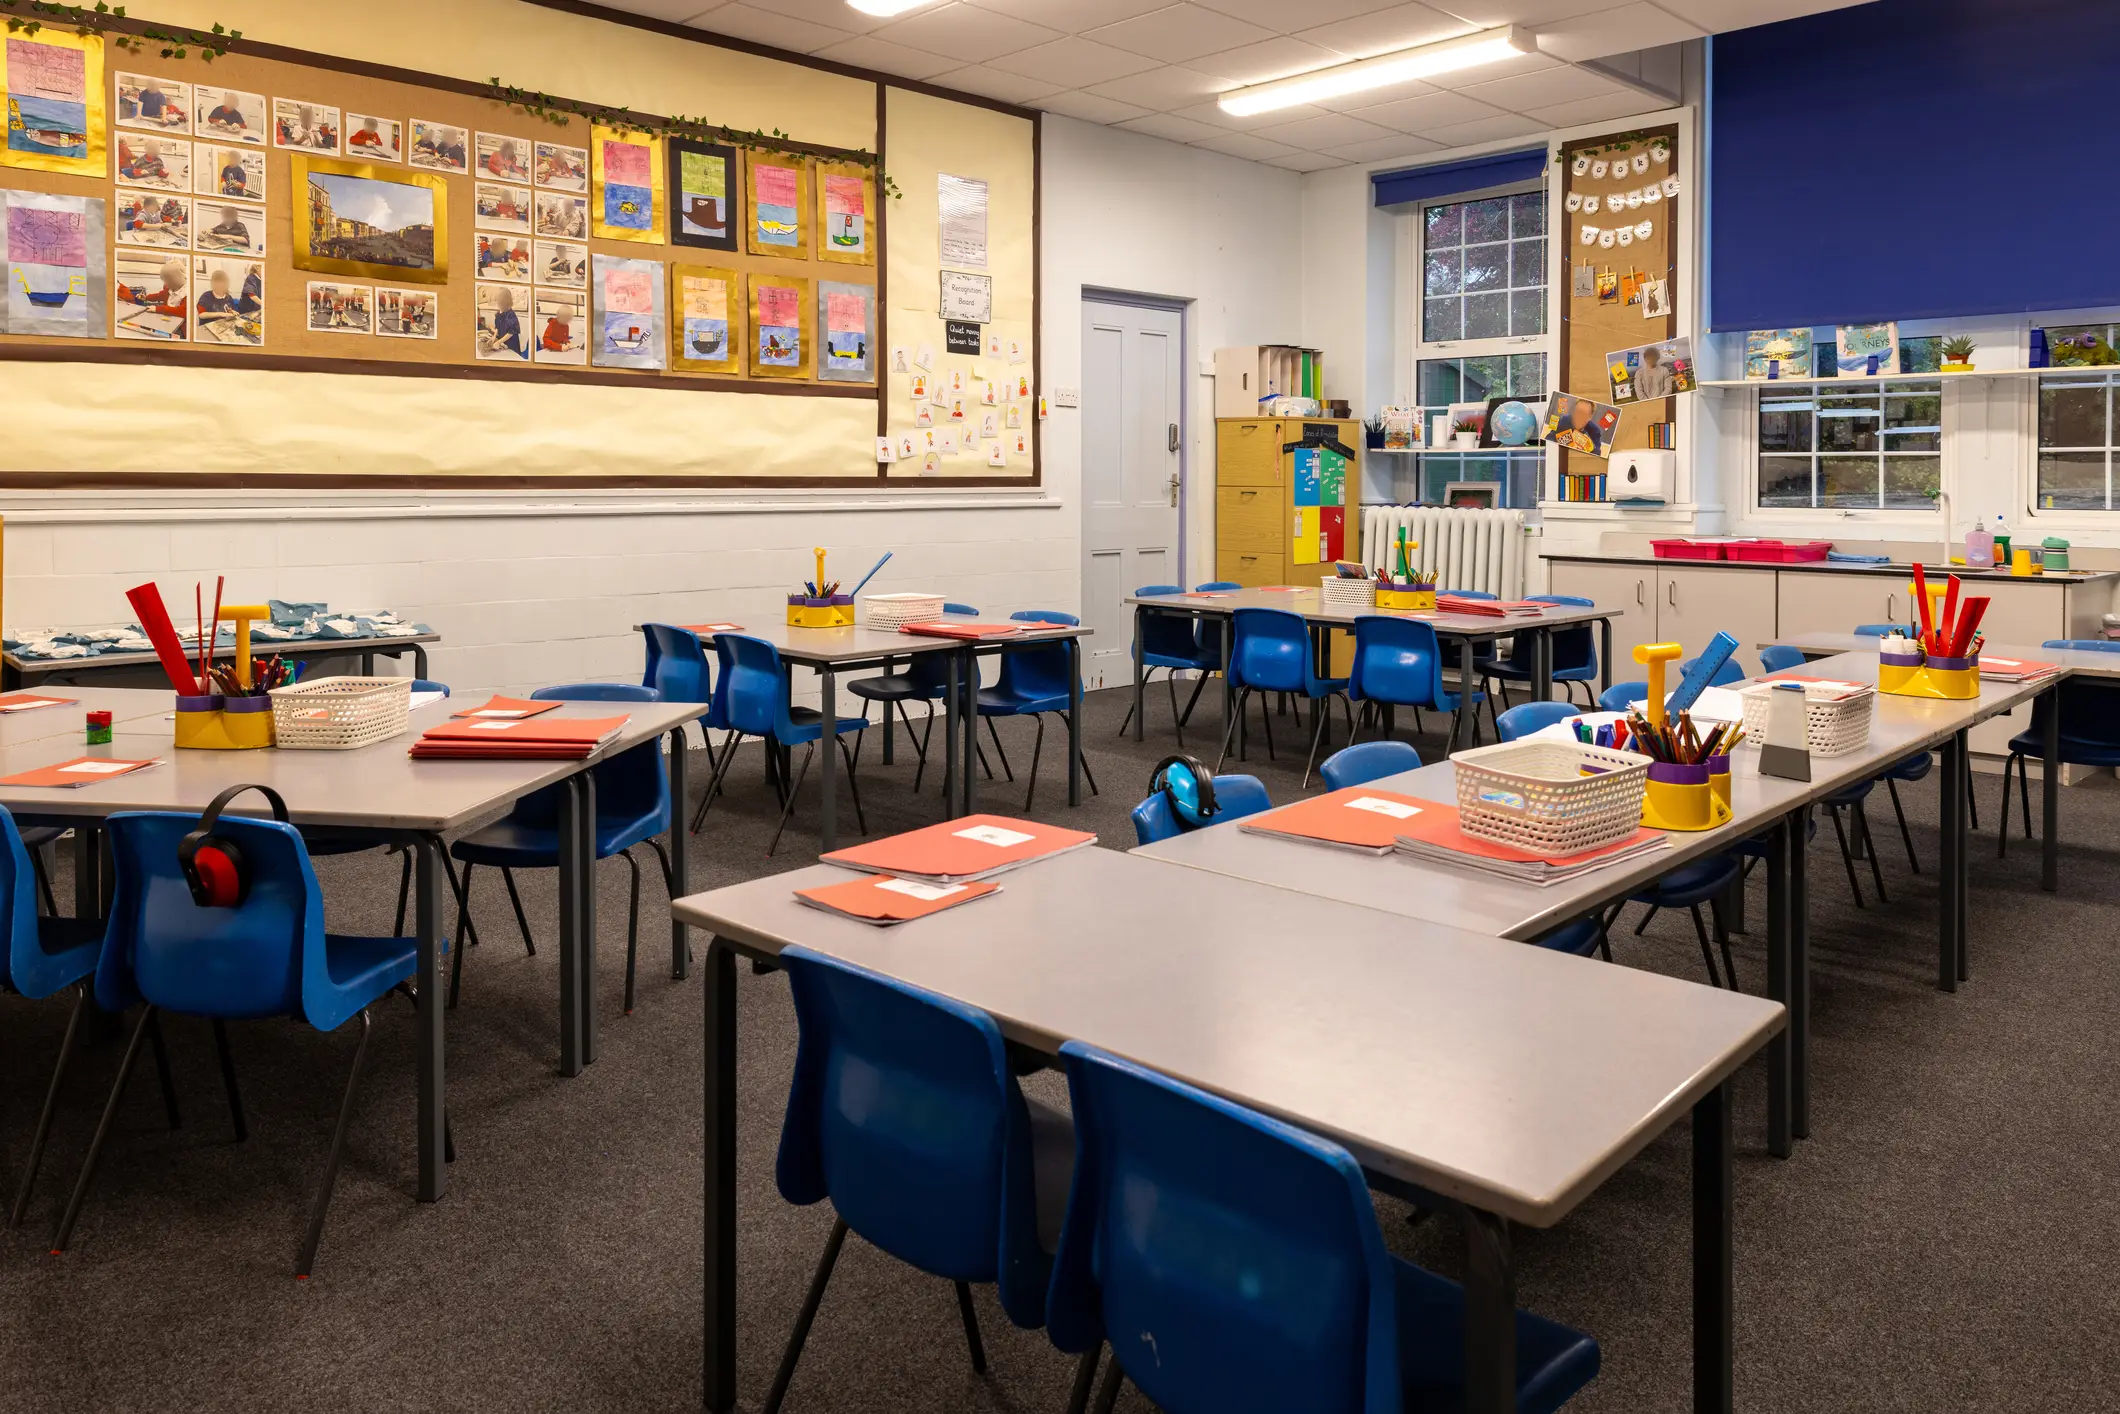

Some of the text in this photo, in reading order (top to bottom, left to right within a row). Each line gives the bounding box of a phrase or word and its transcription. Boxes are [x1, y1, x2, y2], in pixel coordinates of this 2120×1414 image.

[1577, 150, 1664, 172] Books
[951, 284, 982, 295] Recognition
[958, 297, 975, 306] Board
[949, 324, 964, 335] Quiet
[948, 334, 967, 345] between
